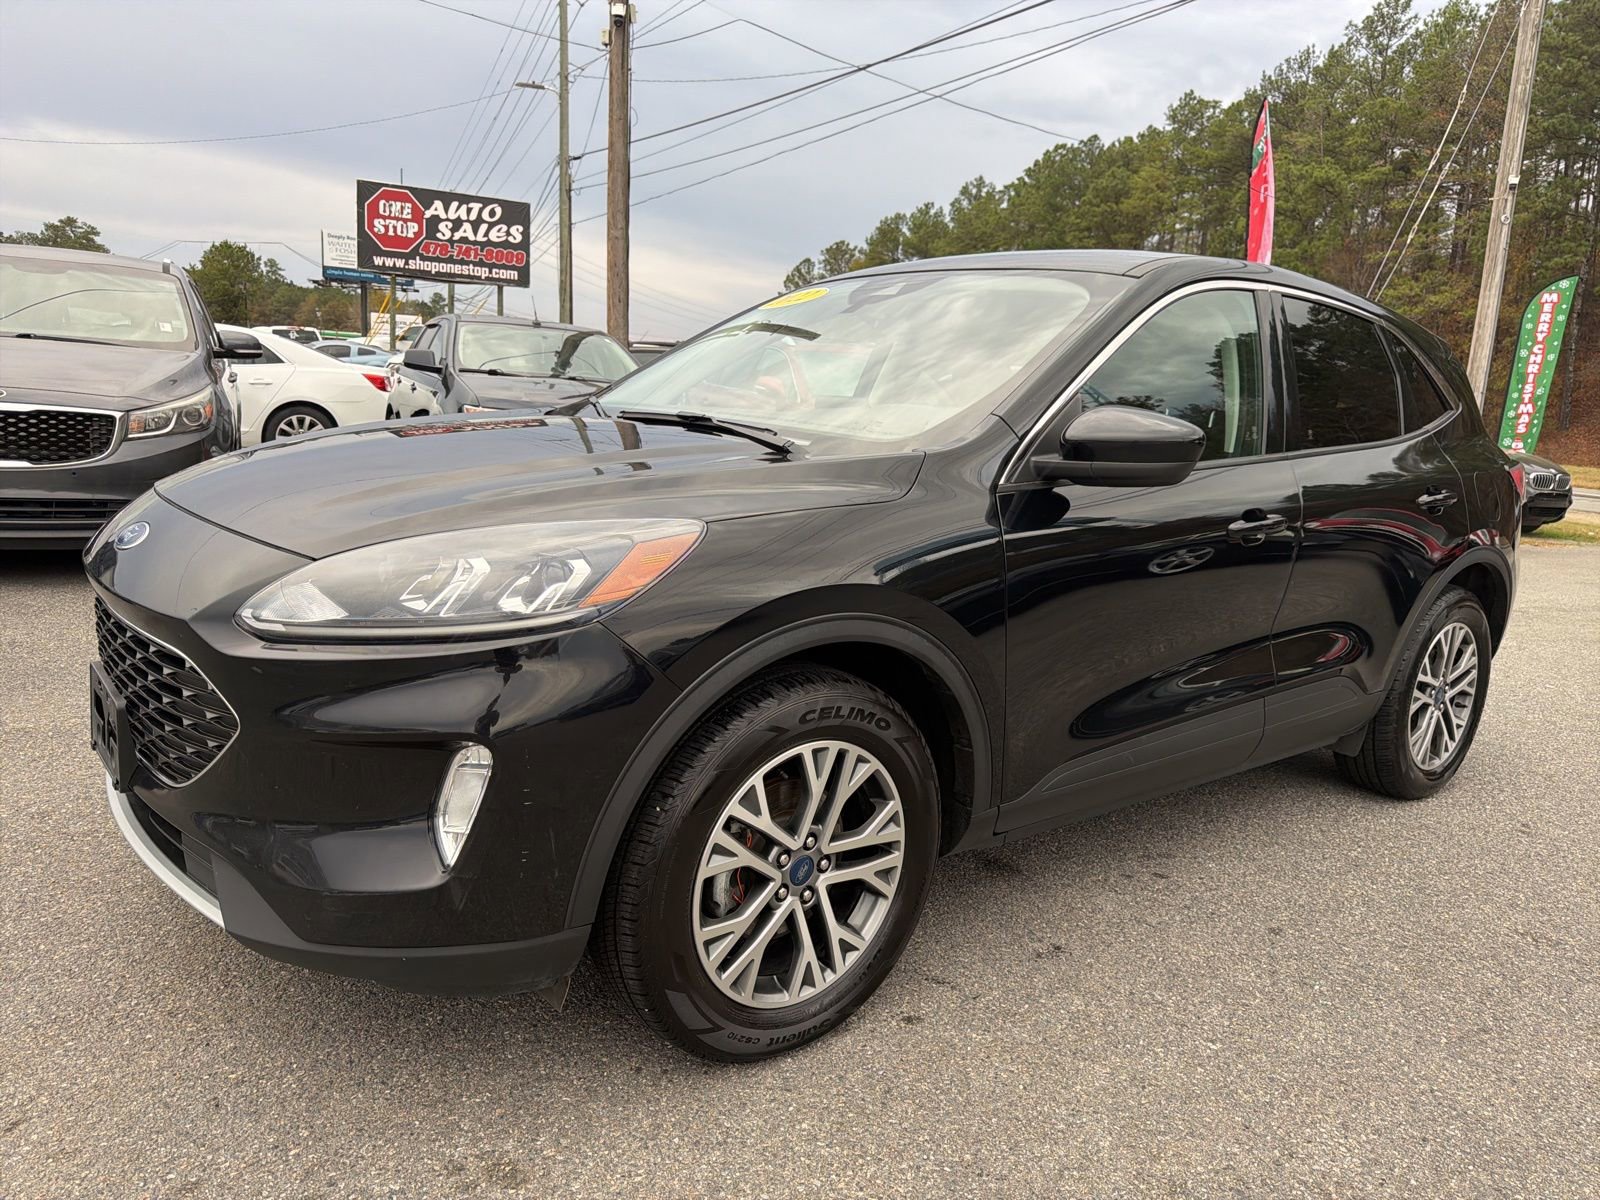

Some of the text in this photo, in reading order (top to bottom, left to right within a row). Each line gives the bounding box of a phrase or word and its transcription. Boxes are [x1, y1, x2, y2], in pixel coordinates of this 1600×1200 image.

[379, 199, 412, 219] ONE
[424, 200, 502, 222] AUTO
[374, 218, 418, 238] STOP
[437, 222, 523, 243] SALES
[373, 256, 518, 280] www.shoponestop.com
[1535, 292, 1559, 342] MERRY
[1515, 344, 1544, 434] CHRISTMAS
[798, 706, 891, 731] CELIMO
[727, 1031, 760, 1045] CS210
